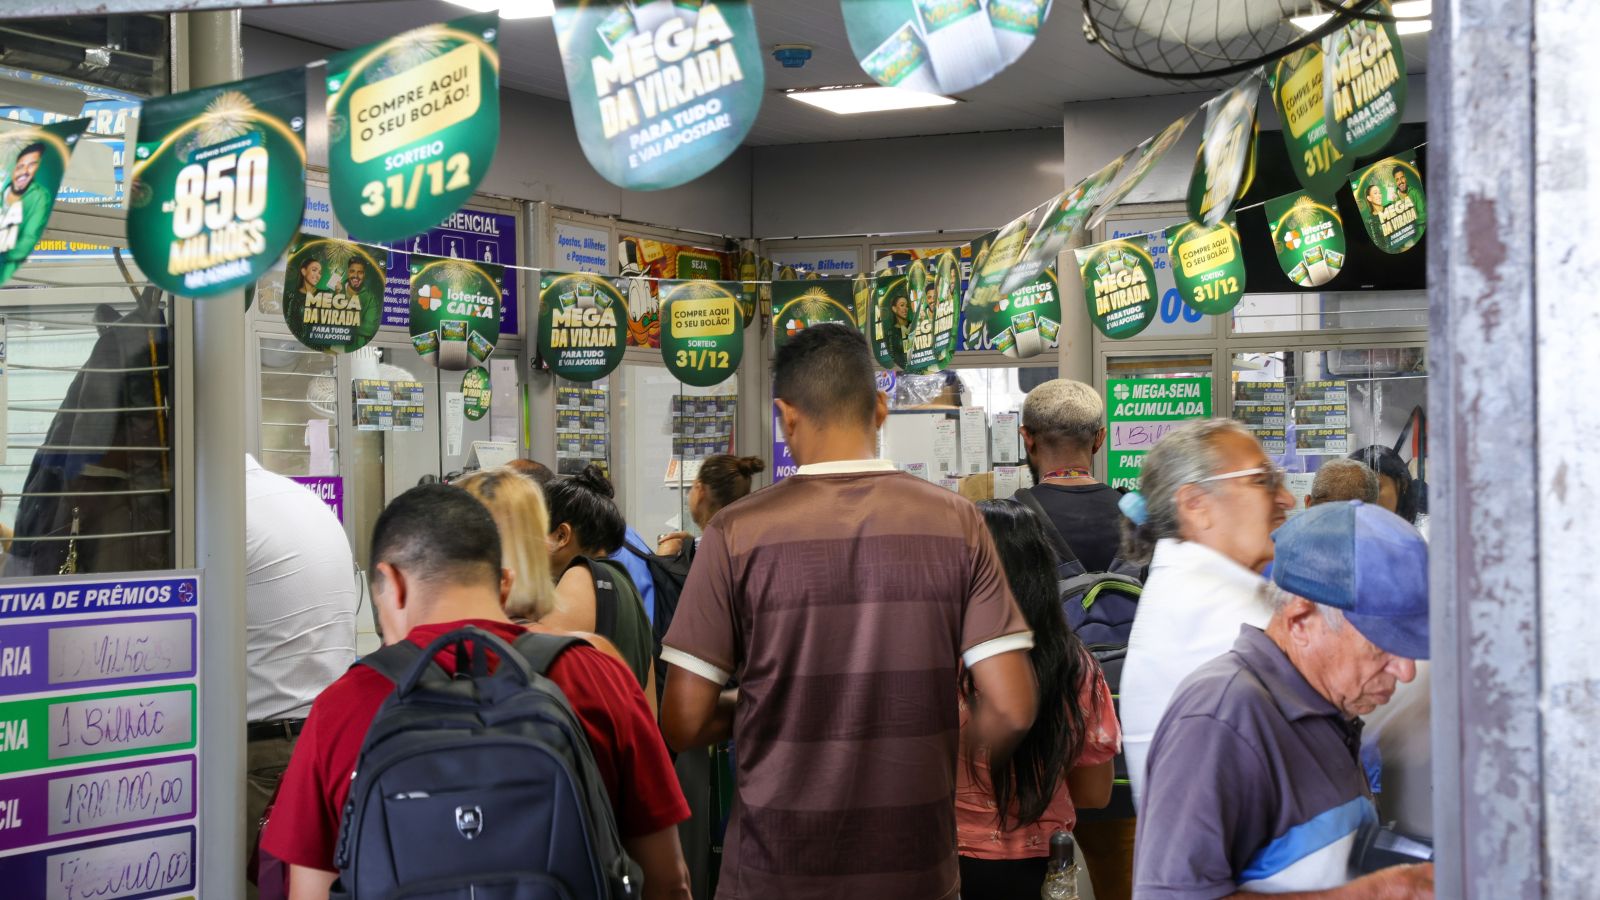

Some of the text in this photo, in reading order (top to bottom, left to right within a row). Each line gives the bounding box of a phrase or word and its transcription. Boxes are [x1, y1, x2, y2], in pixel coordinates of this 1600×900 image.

[591, 4, 734, 97] MEGA
[1332, 24, 1392, 88] MEGA
[1351, 50, 1399, 108] VIRADA
[357, 65, 467, 123] COMPRE AQUI
[599, 42, 744, 139] DA VIRADA
[1286, 83, 1310, 110] COMPRE
[360, 84, 470, 141] O SEU BOLÃO!
[1297, 102, 1308, 117] SEU
[1347, 91, 1392, 128] PARA TUDO
[629, 98, 722, 149] PARA TUDO
[628, 113, 731, 169] E VAI APOSTAR!
[385, 140, 444, 171] SORTEIO
[172, 146, 268, 239] 850
[360, 152, 470, 217] 31/12
[1379, 196, 1414, 223] MEGA
[1301, 220, 1333, 237] loterias
[1381, 208, 1417, 237] DA VIRADA
[558, 235, 606, 251] Apostas, Bilhetes
[1304, 228, 1335, 245] CAIXA
[168, 218, 266, 276] MILHÕES
[1183, 238, 1227, 260] COMPRE AQUI
[572, 251, 606, 266] Pagamentos
[691, 259, 707, 270] SEJA
[818, 259, 854, 270] Bilhetes
[1154, 258, 1165, 269] de
[1186, 246, 1230, 269] O SEU BOLÃO!
[1093, 265, 1147, 297] MEGA
[1201, 270, 1225, 282] SORTEIO
[447, 288, 494, 305] loterias
[1013, 290, 1054, 308] CAIXA
[1096, 283, 1150, 316] DA VIRADA
[1193, 277, 1239, 302] 31/12
[305, 291, 361, 310] MEGA
[447, 301, 493, 319] CAIXA
[304, 307, 360, 326] DA VIRADA
[552, 307, 617, 327] MEGA
[674, 308, 729, 318] COMPRE AQUI
[685, 320, 698, 328] SEU
[700, 317, 730, 327] BOLÃO!
[1106, 305, 1142, 322] PARA TUDO
[1119, 313, 1145, 326] APOSTAR!
[551, 328, 616, 347] DA VIRADA
[688, 340, 717, 348] SORTEIO
[561, 350, 581, 358] PARA
[575, 358, 606, 366] APOSTAR!
[676, 349, 729, 371] 31/12
[1132, 383, 1200, 399] MEGA-SENA
[1113, 401, 1204, 416] ACUMULADA
[1115, 425, 1121, 446] 1
[52, 590, 80, 609] DE
[84, 584, 172, 607] PRÊMIOS
